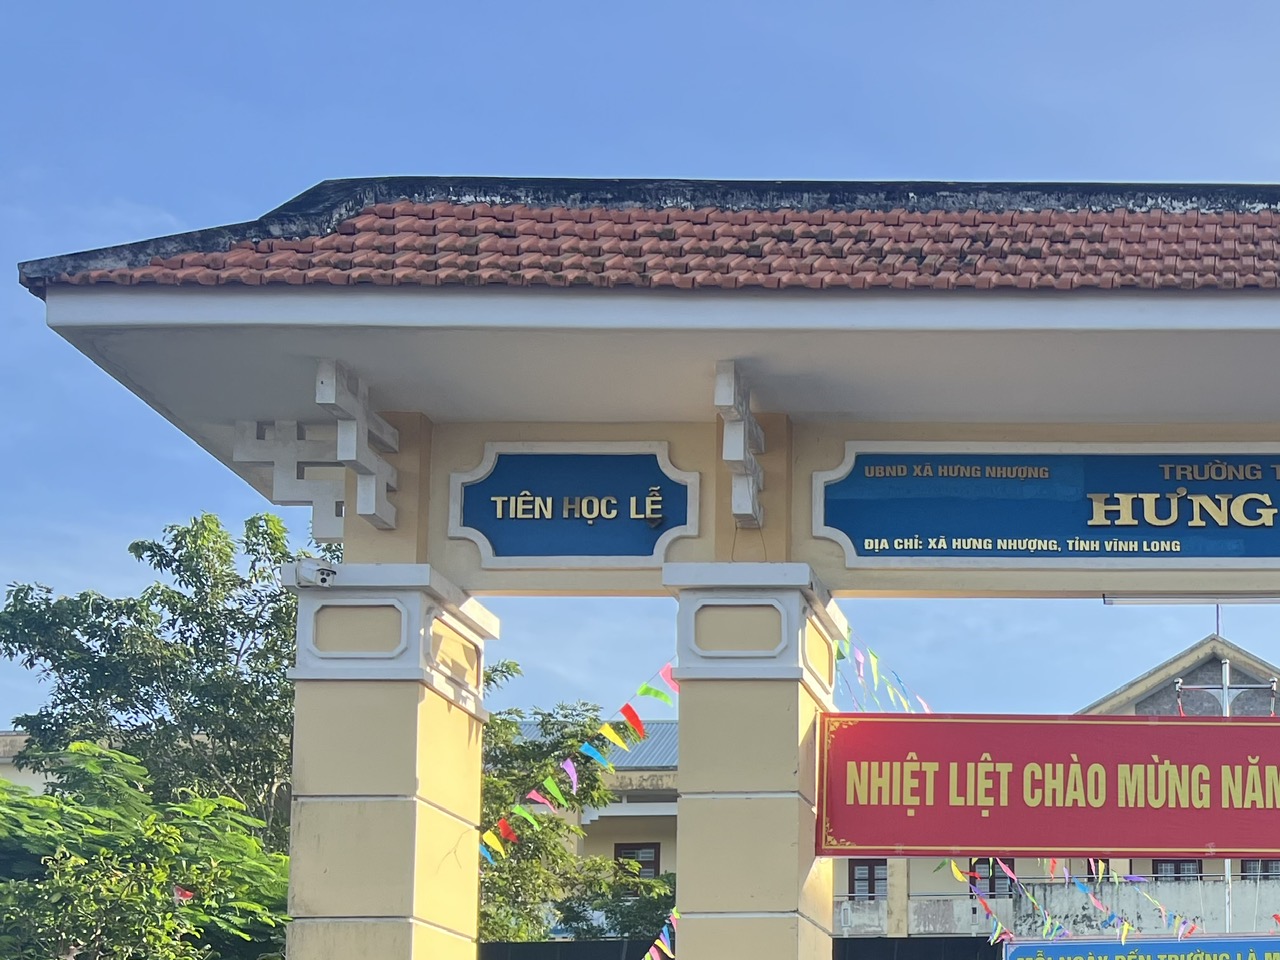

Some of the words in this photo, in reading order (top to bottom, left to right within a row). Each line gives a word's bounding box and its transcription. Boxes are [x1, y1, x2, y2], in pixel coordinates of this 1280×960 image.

[864, 465, 908, 478] UBND
[913, 463, 933, 478] XÃ
[938, 465, 981, 478] HƯNG
[985, 466, 1049, 480] NHƯỢNG
[1159, 460, 1262, 480] TRƯỜNG
[562, 496, 618, 525] HỌC
[630, 486, 663, 519] LỄ
[1086, 487, 1278, 527] HƯNG
[864, 538, 889, 552] ĐỊA
[894, 535, 922, 550] CHỈ:
[928, 536, 948, 550] XÃ
[952, 538, 992, 550] HƯNG
[997, 538, 1062, 552] NHƯỢNG,
[1067, 537, 1099, 551] TỈNH
[1104, 538, 1138, 552] VĨNH
[1143, 540, 1180, 552] LONG
[845, 751, 940, 817] NHIỆT
[948, 752, 1013, 817] LIỆT
[1022, 753, 1106, 808] CHÀO
[1117, 754, 1211, 809] MỪNG
